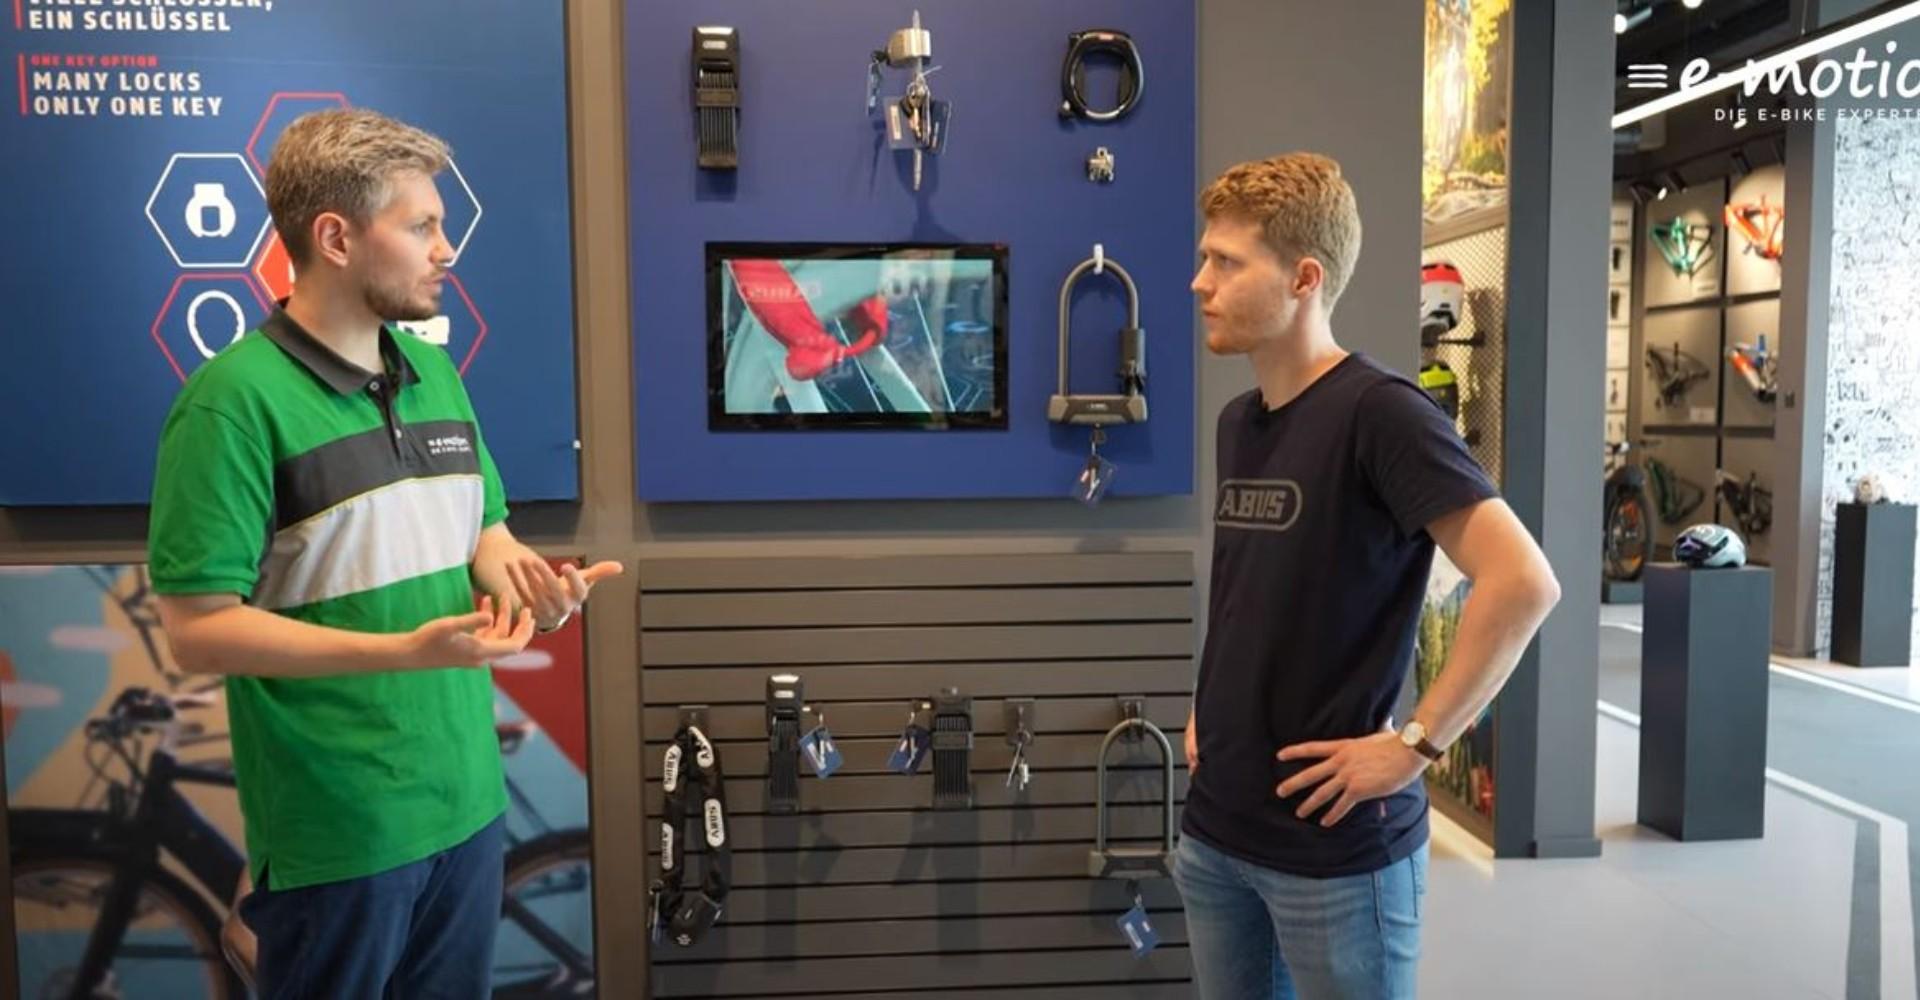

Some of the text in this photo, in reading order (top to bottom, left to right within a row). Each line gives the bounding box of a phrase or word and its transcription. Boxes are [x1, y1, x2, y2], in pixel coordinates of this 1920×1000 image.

[29, 6, 231, 31] EIN SCHLÜSSEL
[34, 72, 201, 91] MANY LOCKS
[34, 96, 222, 116] ONLY ONE KEY
[1219, 488, 1287, 518] ABUS
